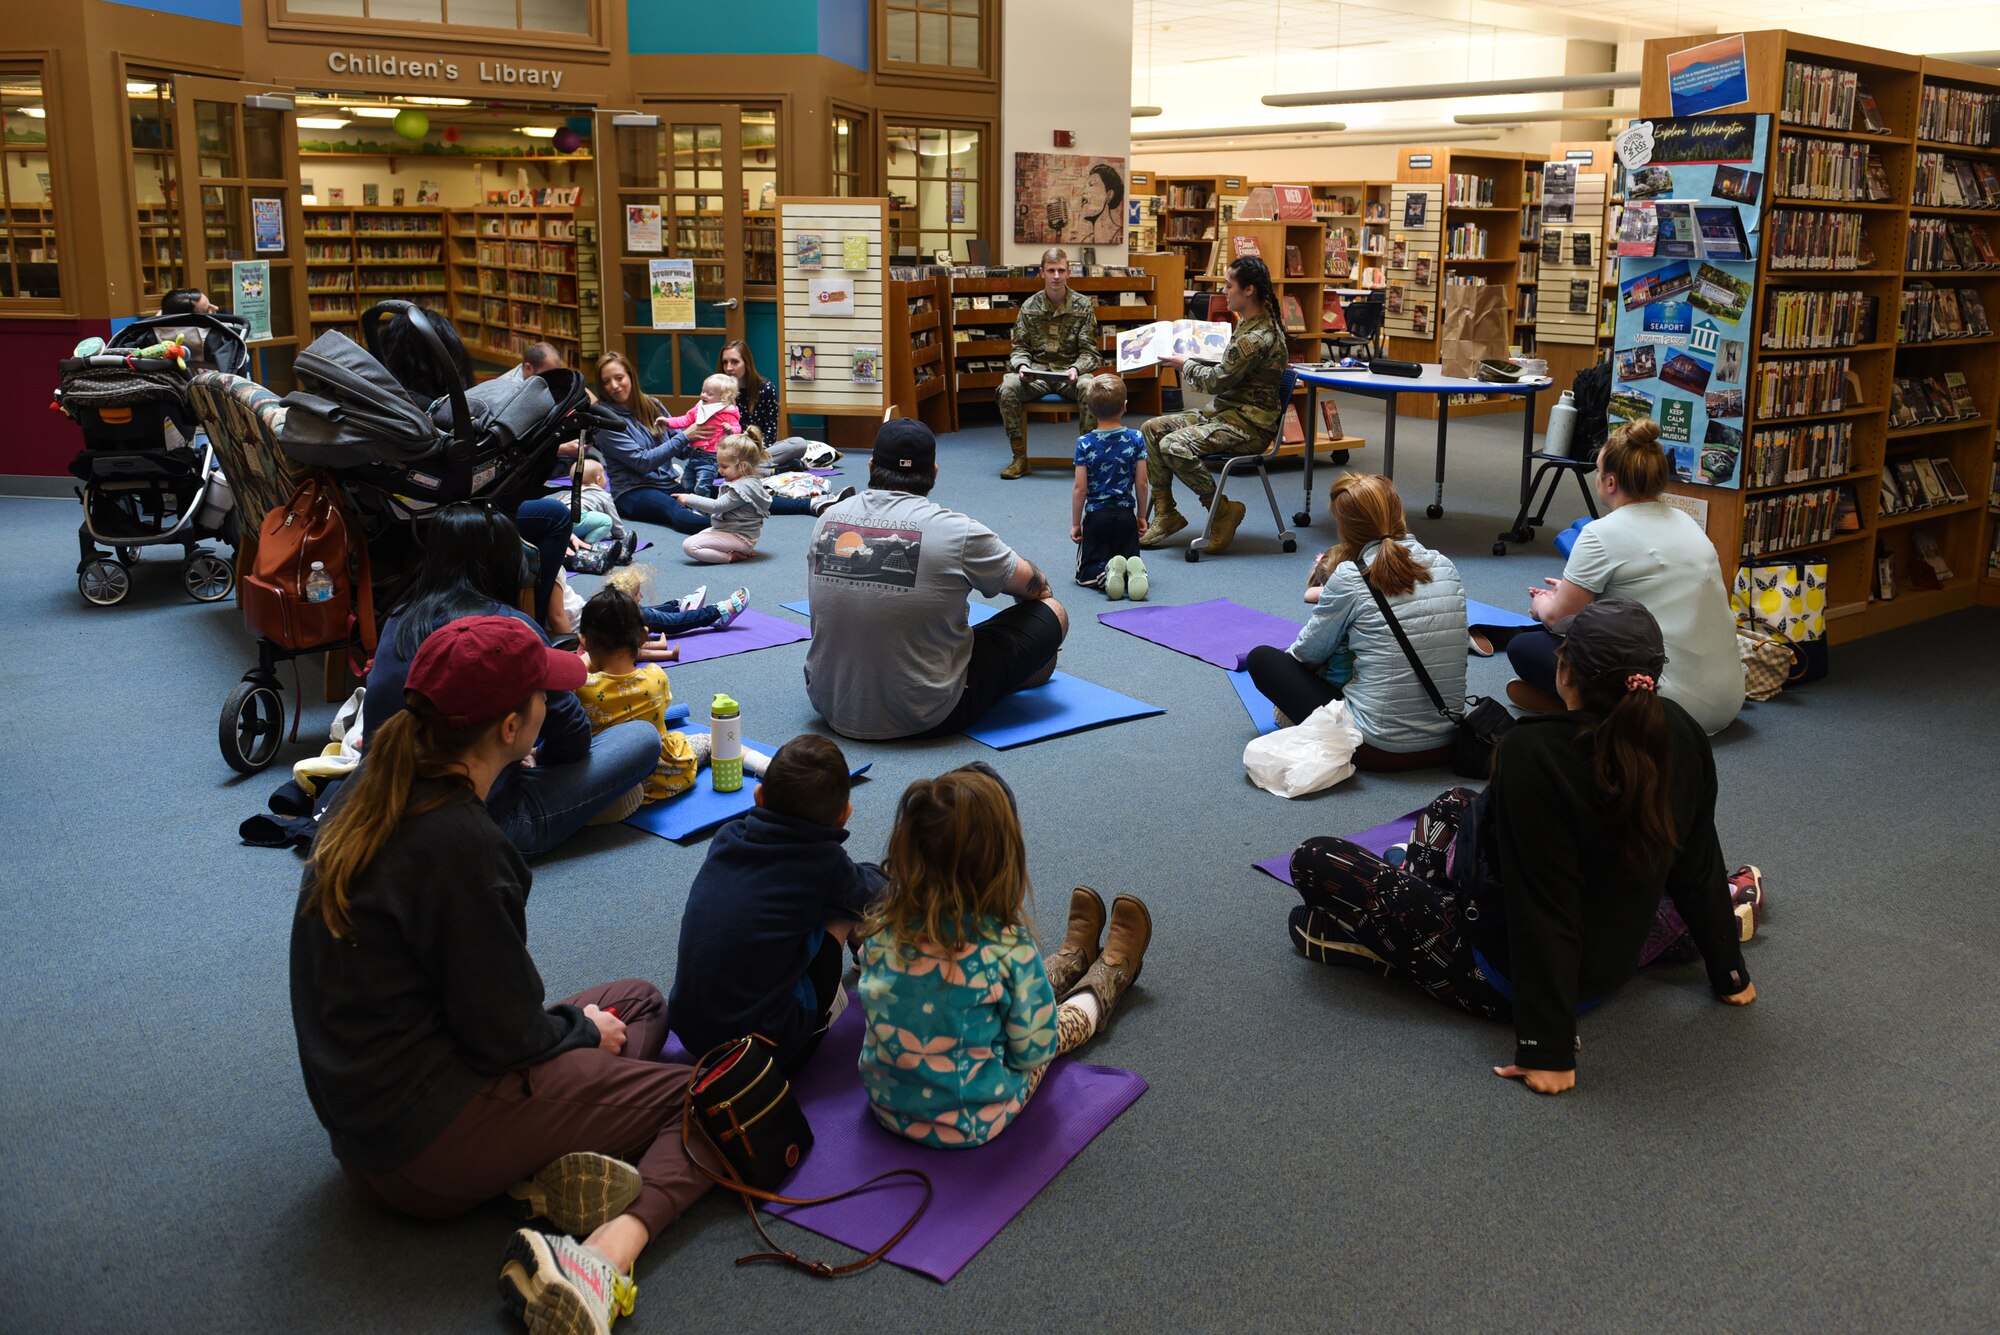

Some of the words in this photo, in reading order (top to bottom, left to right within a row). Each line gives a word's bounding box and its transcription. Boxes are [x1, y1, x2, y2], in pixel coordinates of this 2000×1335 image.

[328, 51, 459, 80] Children's
[479, 61, 563, 89] Library
[1654, 124, 1687, 140] Explore
[1692, 121, 1746, 140] Washington
[1624, 132, 1644, 145] DISCOVER
[1284, 189, 1302, 203] RED
[1650, 323, 1684, 331] SEAPORT
[1634, 333, 1661, 343] Museum
[1661, 335, 1687, 345] Passes
[1667, 415, 1685, 423] CALM
[1662, 425, 1676, 433] VISIT
[1677, 426, 1688, 434] THE
[1662, 432, 1687, 441] MUSEUM
[1679, 499, 1697, 508] OUT
[830, 512, 852, 523] WSU
[849, 580, 909, 592] WASHINGTON
